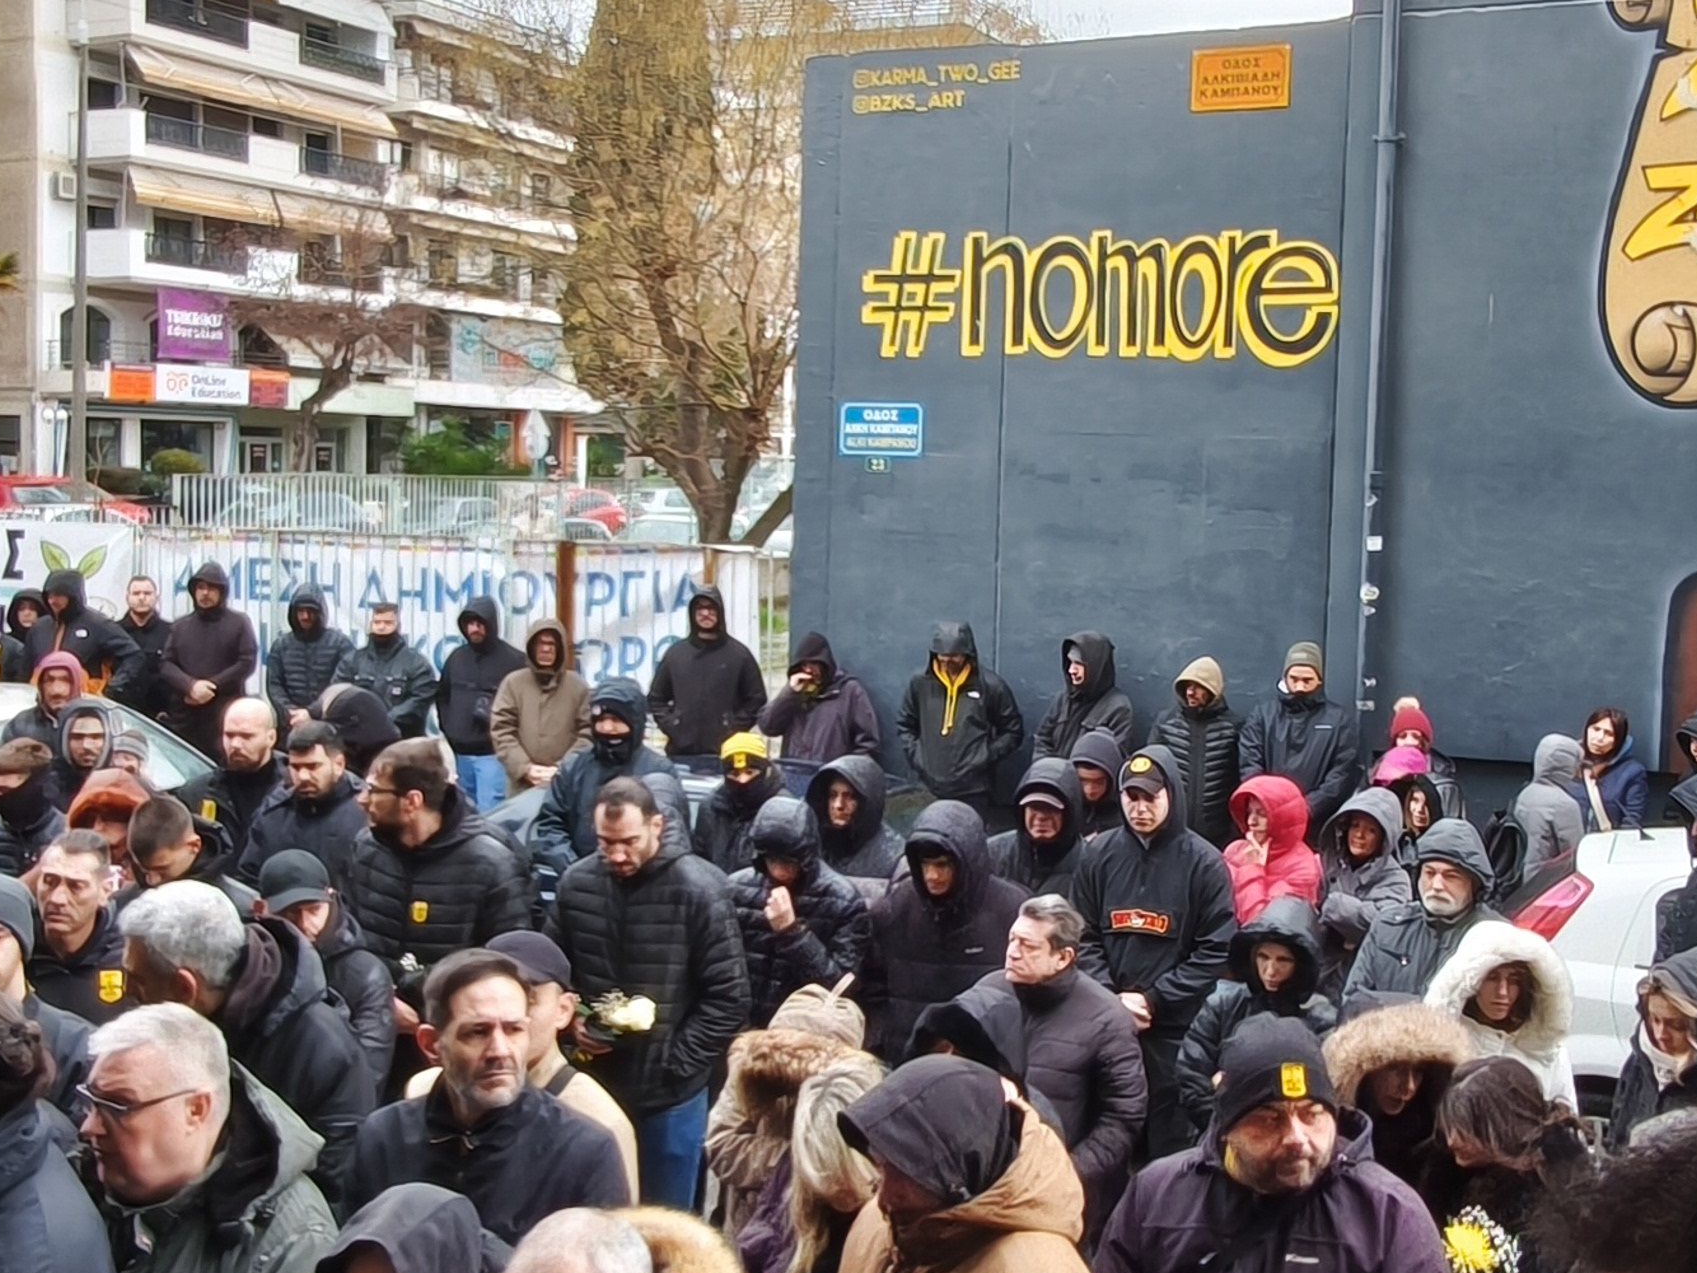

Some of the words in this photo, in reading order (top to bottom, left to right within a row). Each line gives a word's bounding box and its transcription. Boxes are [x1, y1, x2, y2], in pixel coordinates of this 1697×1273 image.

[1222, 57, 1261, 69] ΟΔΟΣ
[1199, 85, 1280, 100] ΚΑΜΠΑΝΟΥ
[861, 228, 1340, 368] #nomore
[862, 409, 899, 421] ΟΔΟΣ
